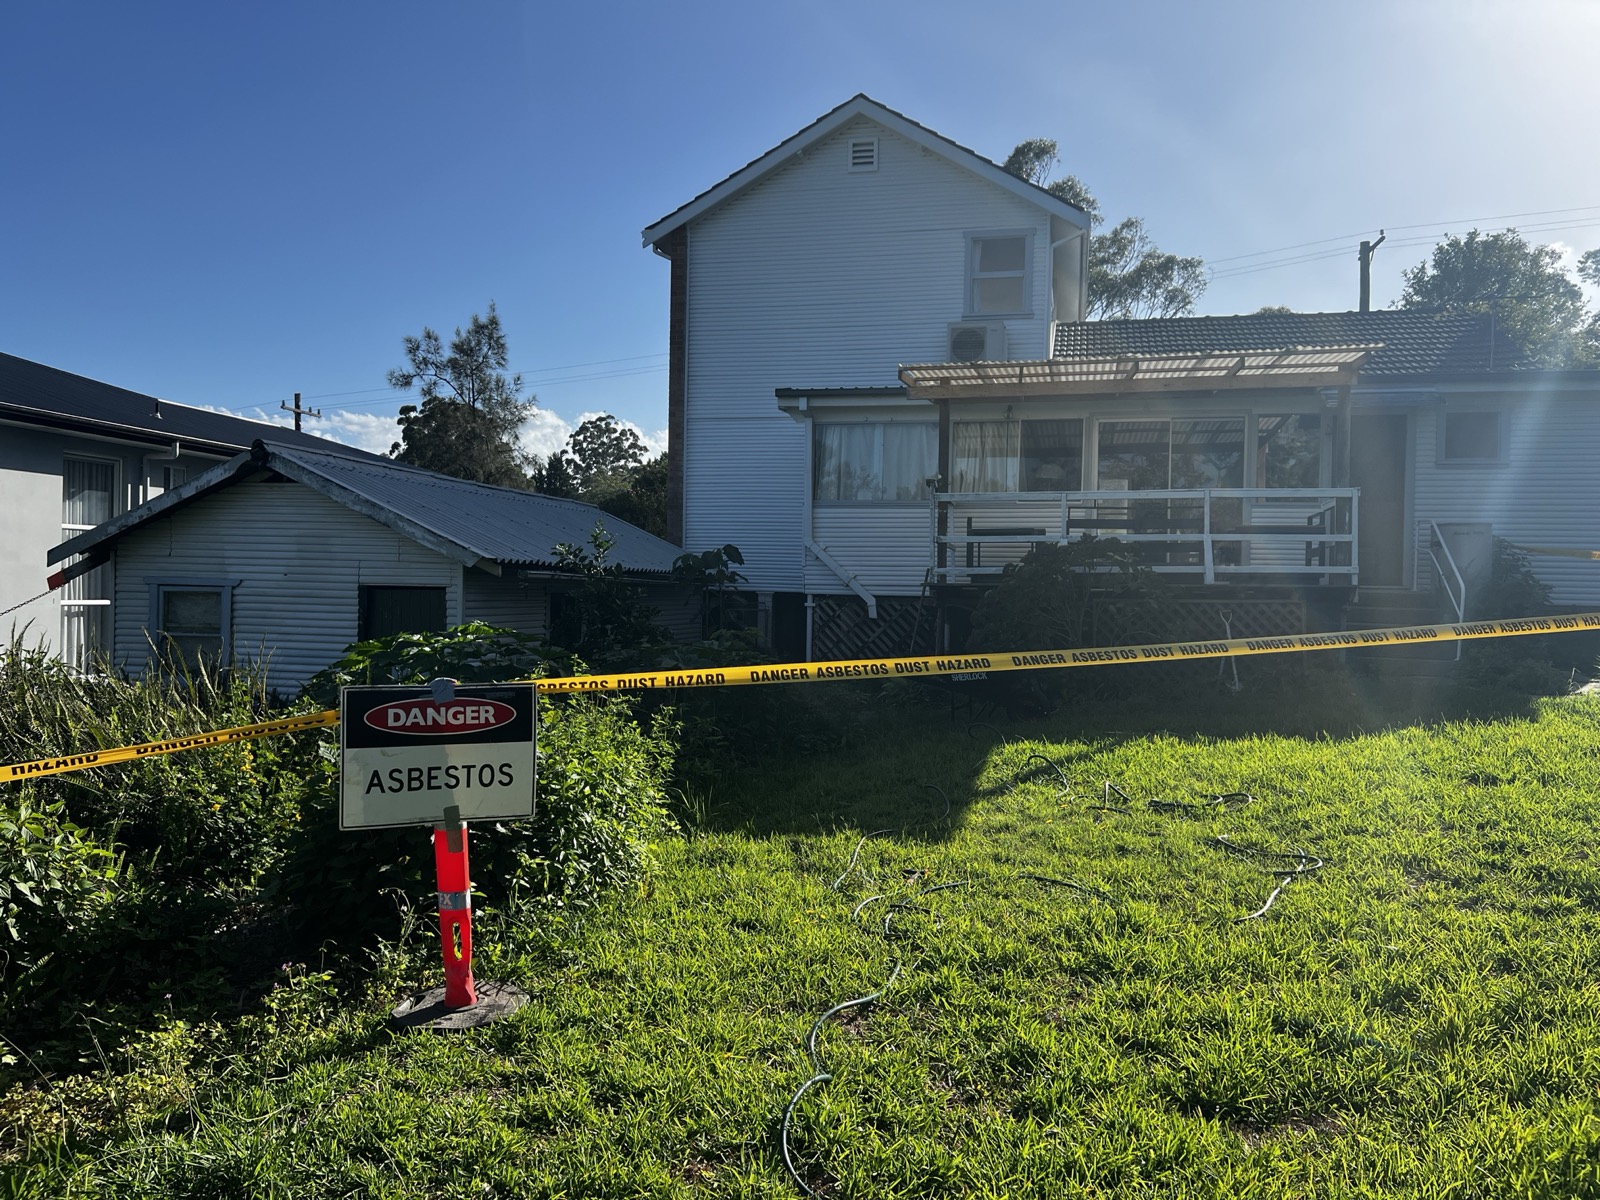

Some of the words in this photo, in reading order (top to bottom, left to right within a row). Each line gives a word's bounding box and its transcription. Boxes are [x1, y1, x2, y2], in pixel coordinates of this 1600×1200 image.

[617, 677, 657, 689] DUST
[665, 673, 726, 686] HAZARD
[750, 667, 810, 683] DANGER
[816, 663, 889, 679] ASBESTOS
[895, 661, 930, 674] DUST
[936, 657, 992, 671] HAZARD
[1011, 653, 1067, 667] DANGER
[1072, 649, 1138, 663] ASBESTOS
[1143, 646, 1175, 658] DUST
[1180, 643, 1230, 656] HAZARD
[1245, 638, 1296, 651] DANGER
[1300, 634, 1358, 647] ASBESTOS
[1361, 632, 1390, 643] DUST
[1394, 628, 1438, 641] HAZARD
[1452, 624, 1497, 636] DANGER
[1499, 620, 1551, 633] ASBESTOS
[1552, 617, 1579, 629] DUST
[951, 672, 988, 682] SHERLOCK
[387, 705, 496, 727] DANGER
[365, 762, 514, 795] ASBESTOS
